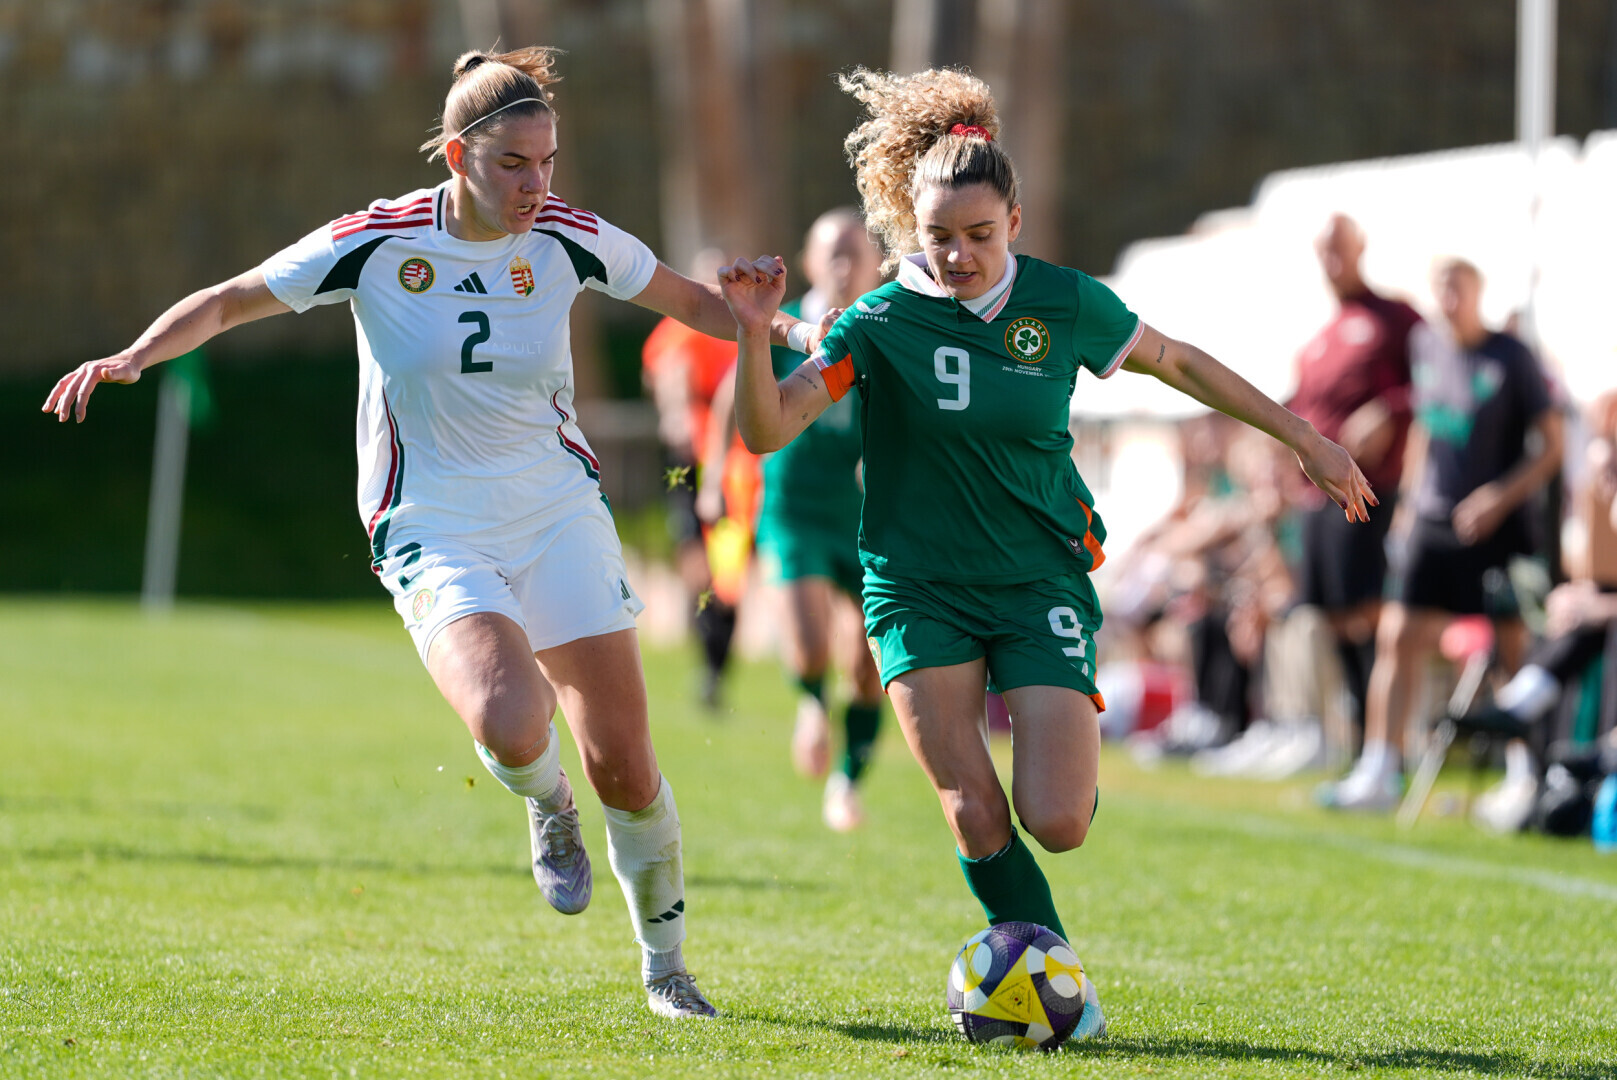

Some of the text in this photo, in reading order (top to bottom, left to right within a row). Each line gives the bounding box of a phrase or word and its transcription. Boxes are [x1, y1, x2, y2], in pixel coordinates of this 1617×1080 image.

[458, 310, 493, 374] 2
[1009, 320, 1046, 336] IRELAND
[934, 346, 970, 411] 9
[1014, 369, 1044, 377] NOVEMBER
[1017, 364, 1042, 372] HUNGARY
[1047, 606, 1087, 657] 9
